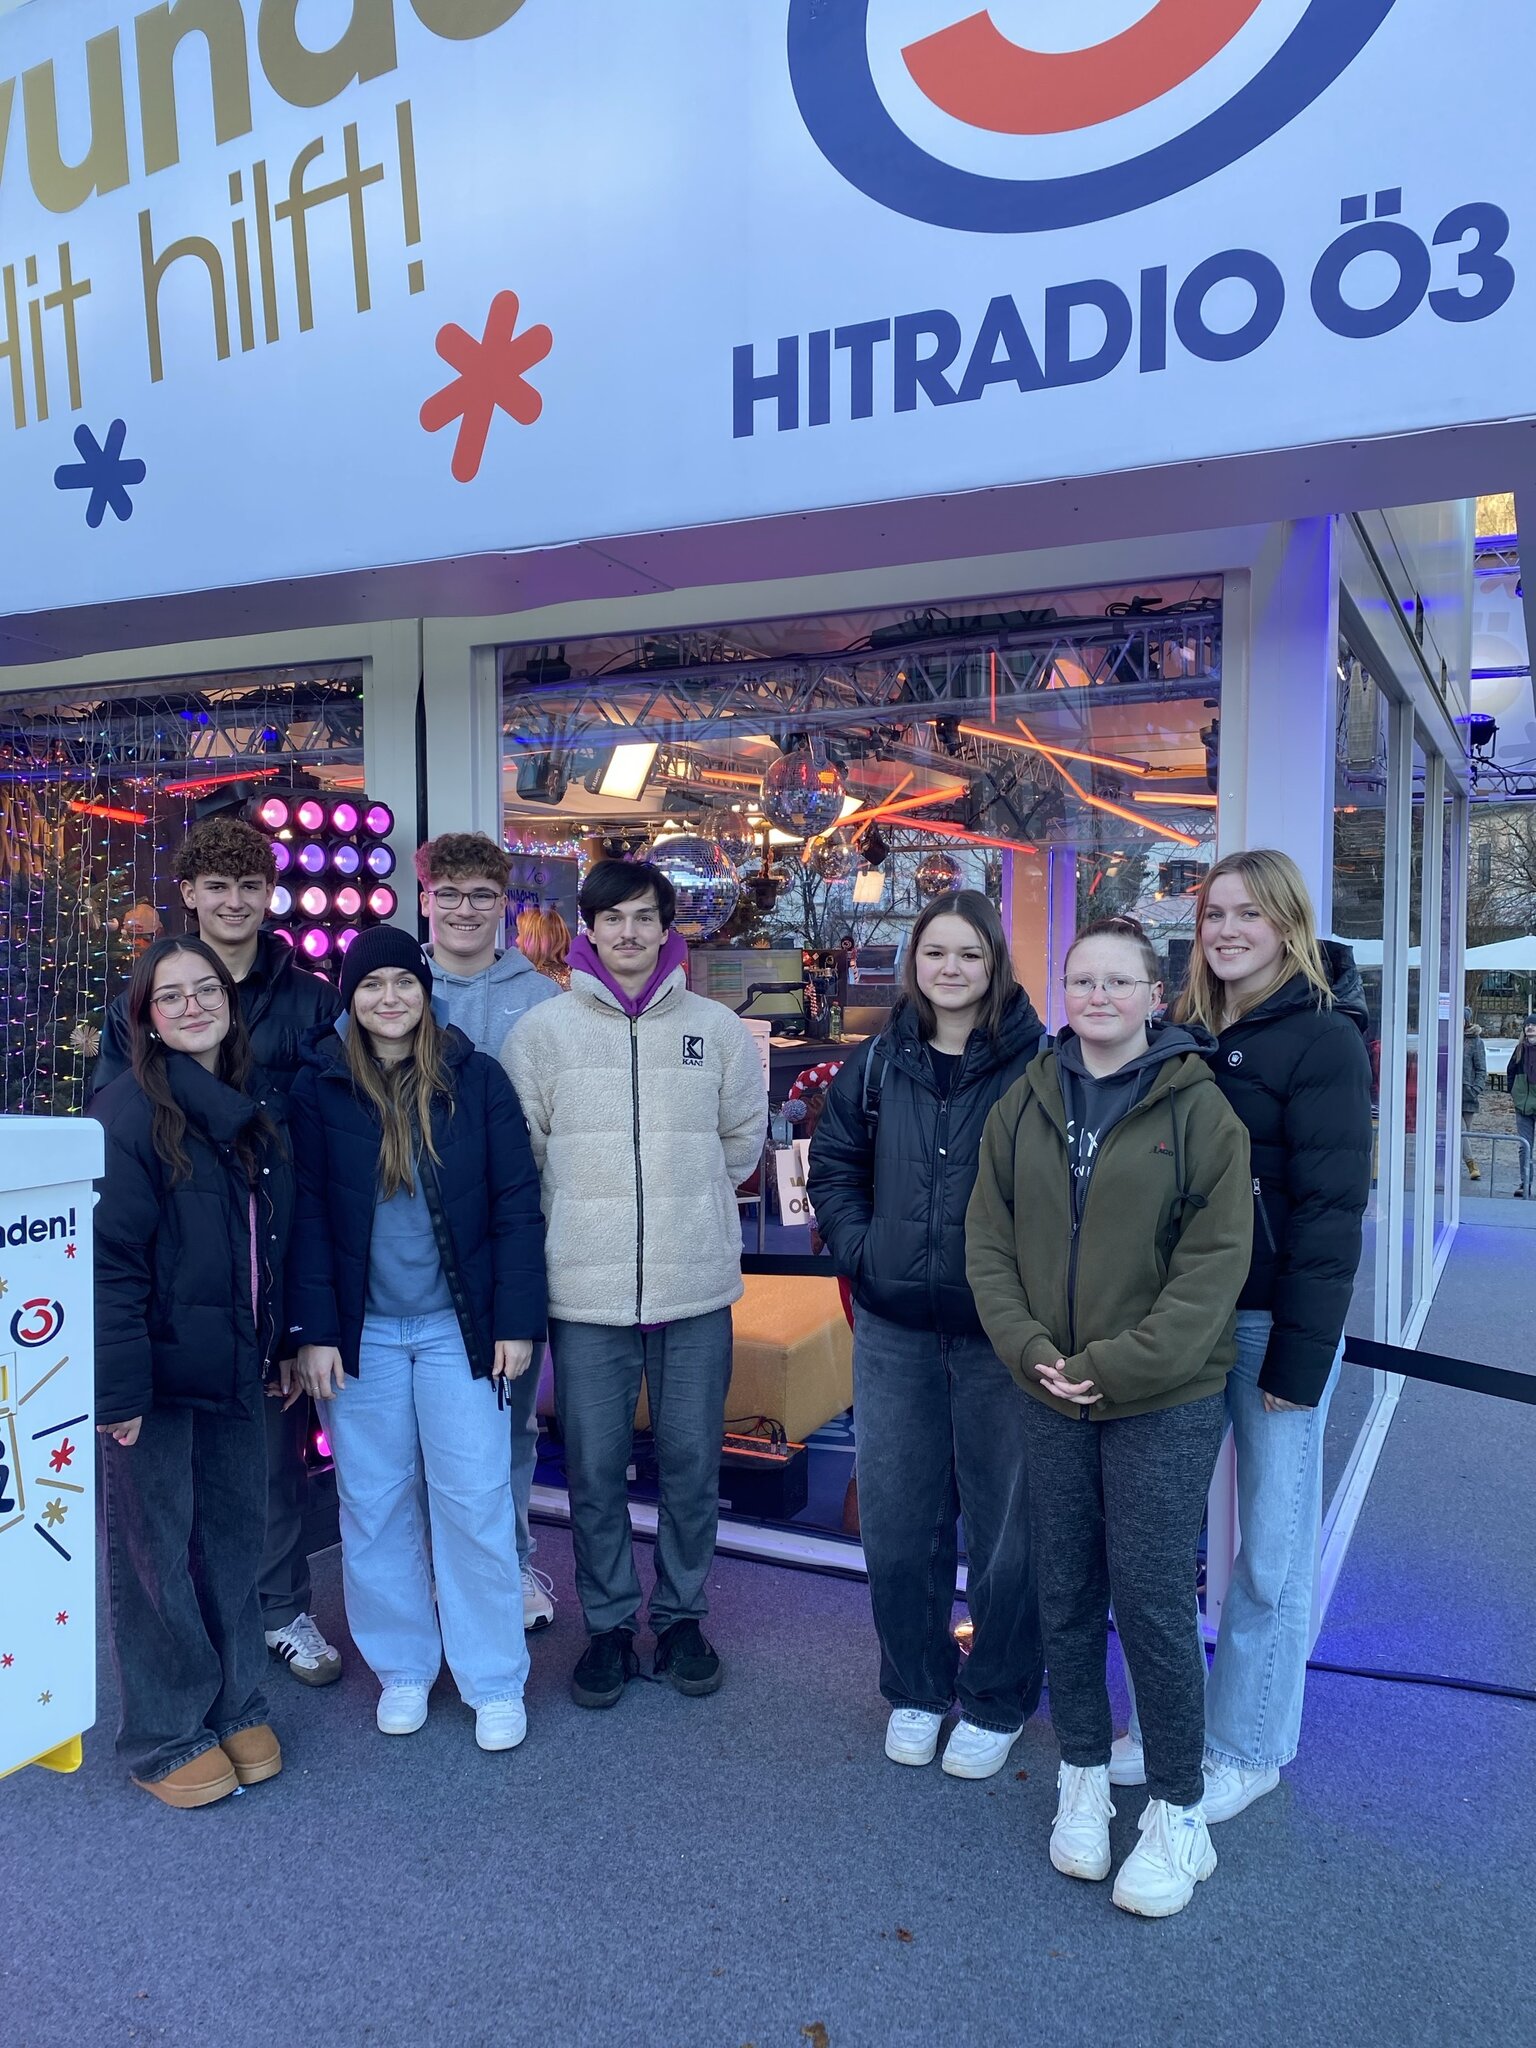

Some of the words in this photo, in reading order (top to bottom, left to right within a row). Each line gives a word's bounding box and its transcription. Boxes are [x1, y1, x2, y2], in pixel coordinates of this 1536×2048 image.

[138, 99, 425, 383] hilft!
[732, 248, 1286, 439] HITRADIO
[1310, 187, 1516, 339] Ö3
